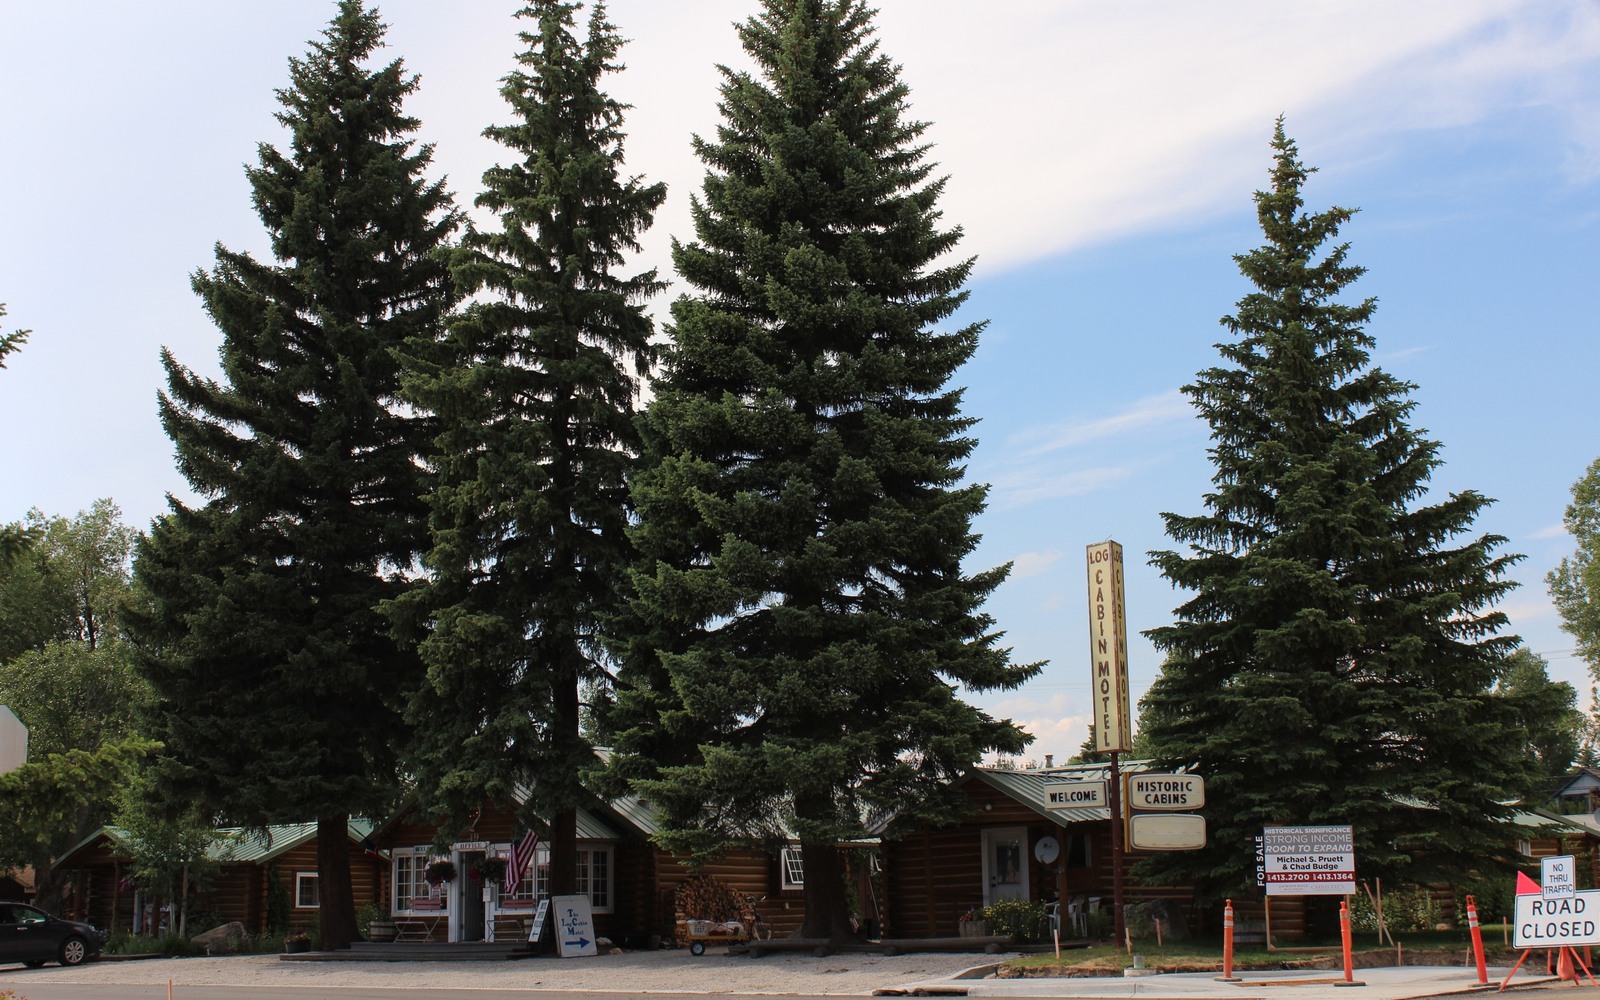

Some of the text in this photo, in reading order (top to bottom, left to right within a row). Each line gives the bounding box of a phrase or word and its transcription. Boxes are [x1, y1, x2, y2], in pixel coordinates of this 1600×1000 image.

[1089, 549, 1108, 564] LOG
[1095, 569, 1107, 655] CABIN
[1116, 569, 1124, 655] CABIN
[1098, 661, 1110, 747] MOTEL
[1120, 660, 1128, 746] MOTEL
[1137, 781, 1193, 793] HISTORIC
[1049, 790, 1097, 803] WELCOME
[1145, 793, 1187, 804] CABINS
[1265, 834, 1352, 844] STRONG INCOME
[1265, 845, 1295, 853] ROOM
[1313, 844, 1353, 852] EXPAND
[1255, 835, 1265, 887] FOR SALE
[1312, 863, 1339, 871] Budge
[1552, 863, 1564, 872] NO
[1549, 874, 1568, 883] THRU
[1544, 884, 1573, 894] TRAFFIC
[1532, 898, 1586, 916] ROAD
[1522, 920, 1595, 939] CLOSED
